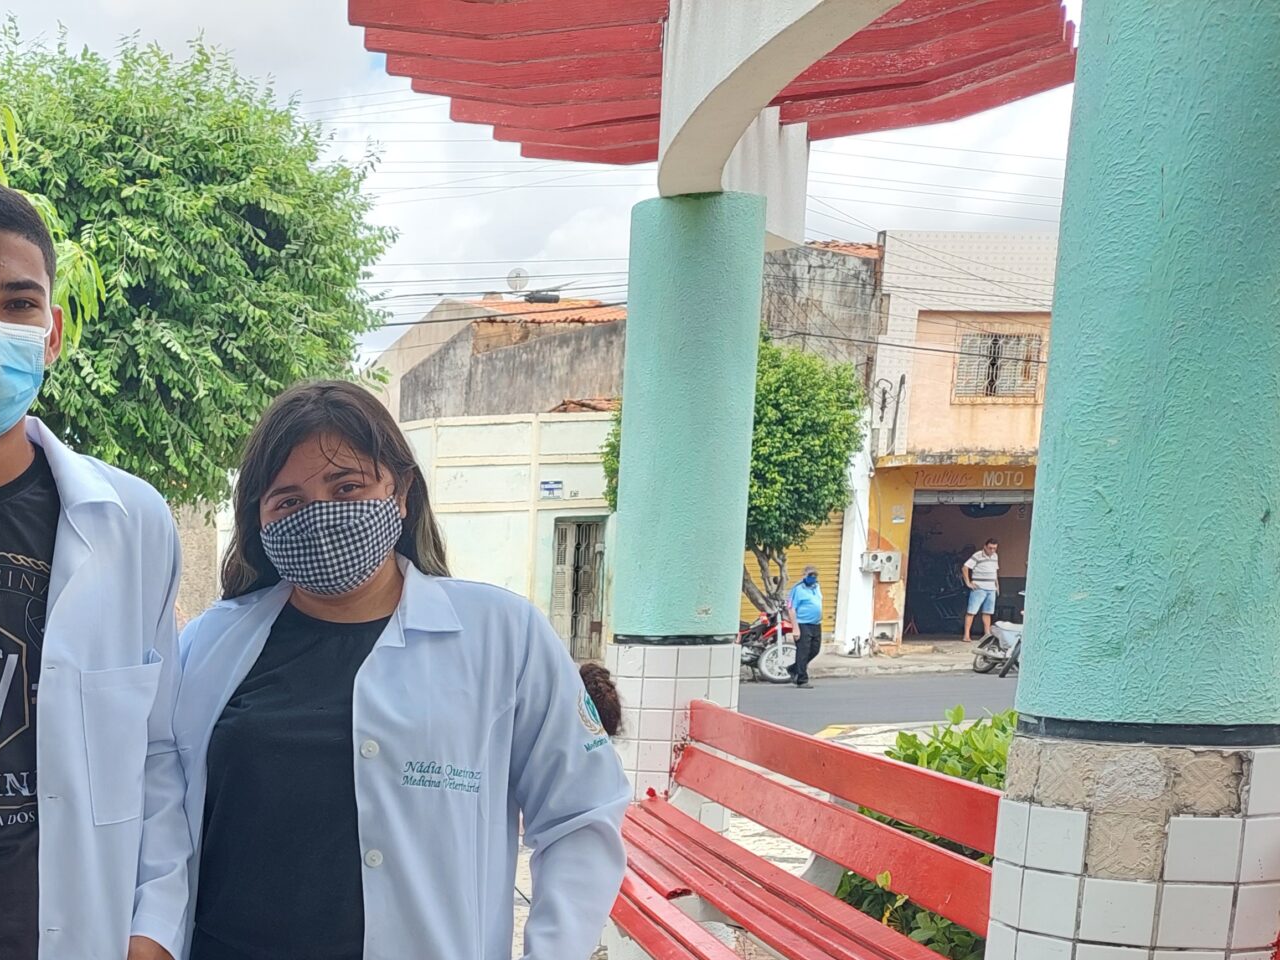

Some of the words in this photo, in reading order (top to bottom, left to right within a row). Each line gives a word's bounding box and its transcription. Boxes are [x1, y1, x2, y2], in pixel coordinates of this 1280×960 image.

[982, 470, 1025, 487] MOTO
[403, 761, 441, 775] Nádia
[401, 775, 441, 788] Medicina
[7, 810, 36, 825] DOS
